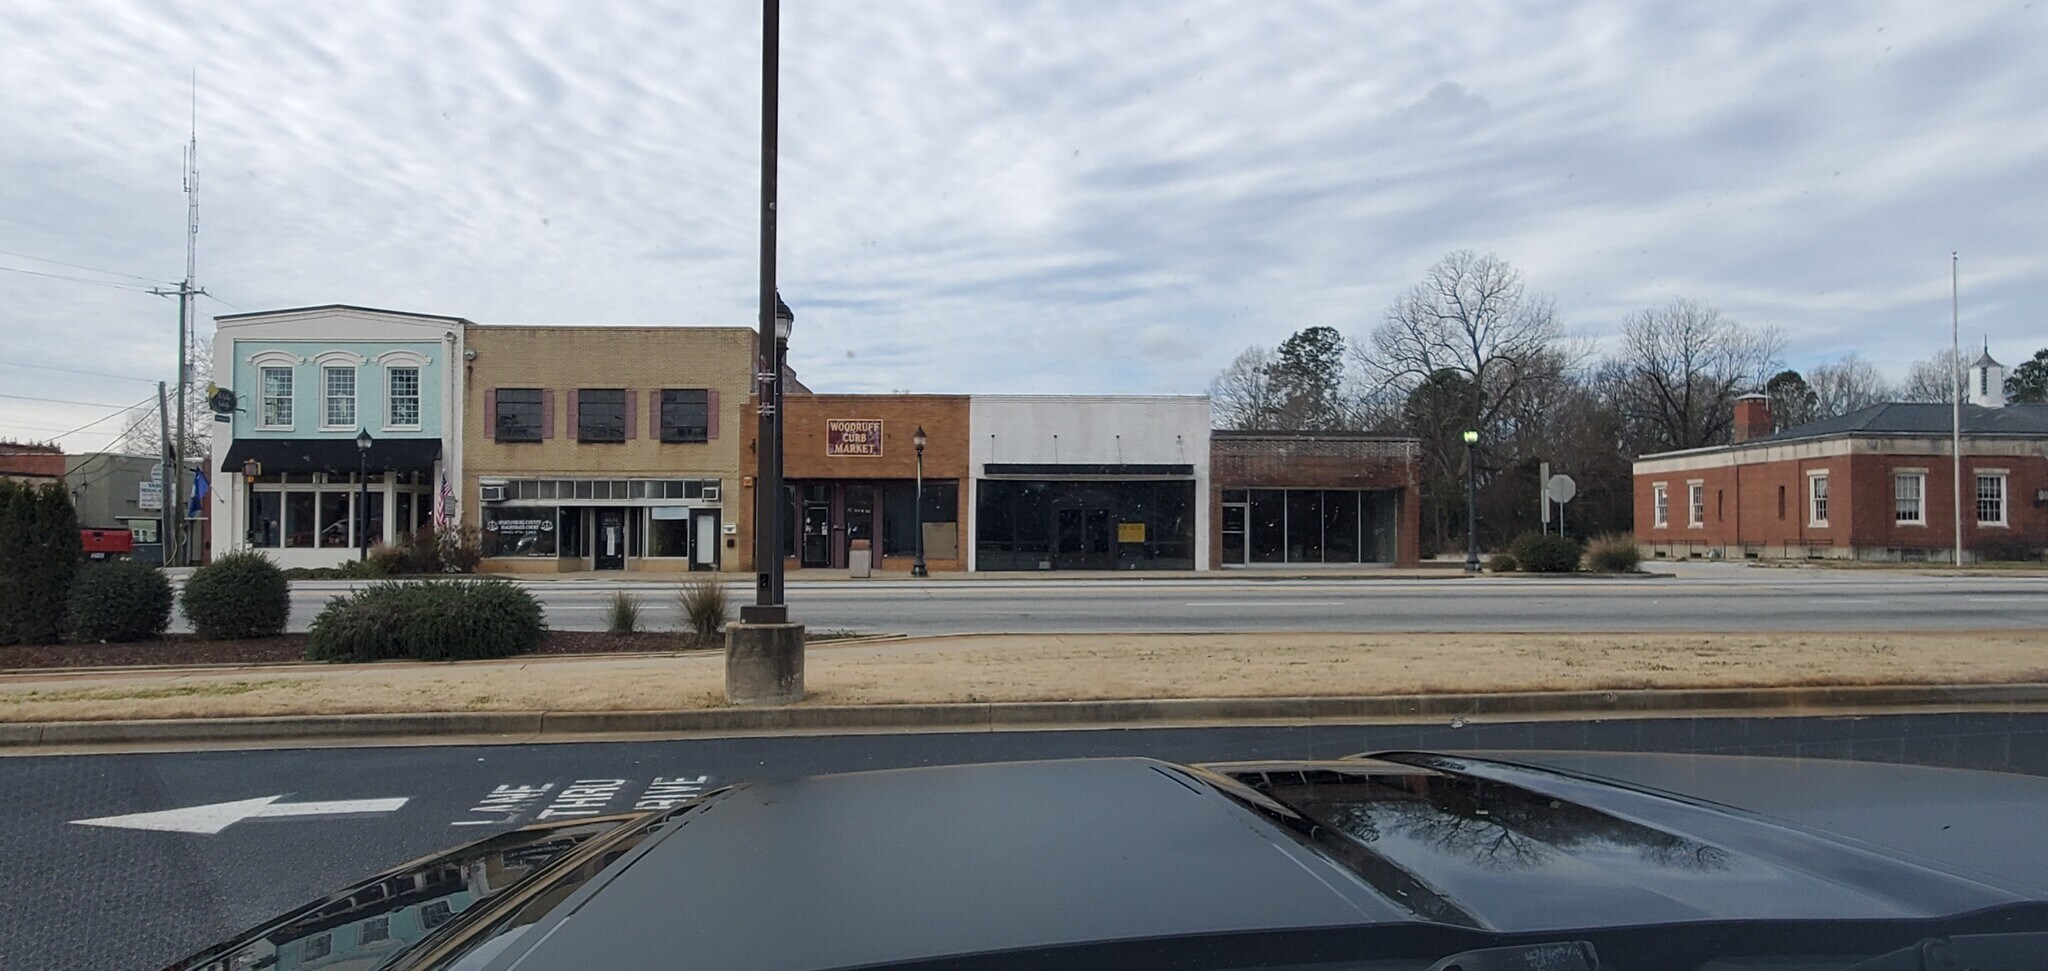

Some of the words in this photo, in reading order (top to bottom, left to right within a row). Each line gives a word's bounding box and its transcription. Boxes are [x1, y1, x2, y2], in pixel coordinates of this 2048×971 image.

[830, 422, 880, 432] WOODRUFF
[842, 433, 867, 442] CURB
[834, 444, 875, 454] MARKET
[536, 779, 626, 820] THRU
[632, 775, 708, 810] RIVE
[451, 783, 554, 826] LANE
